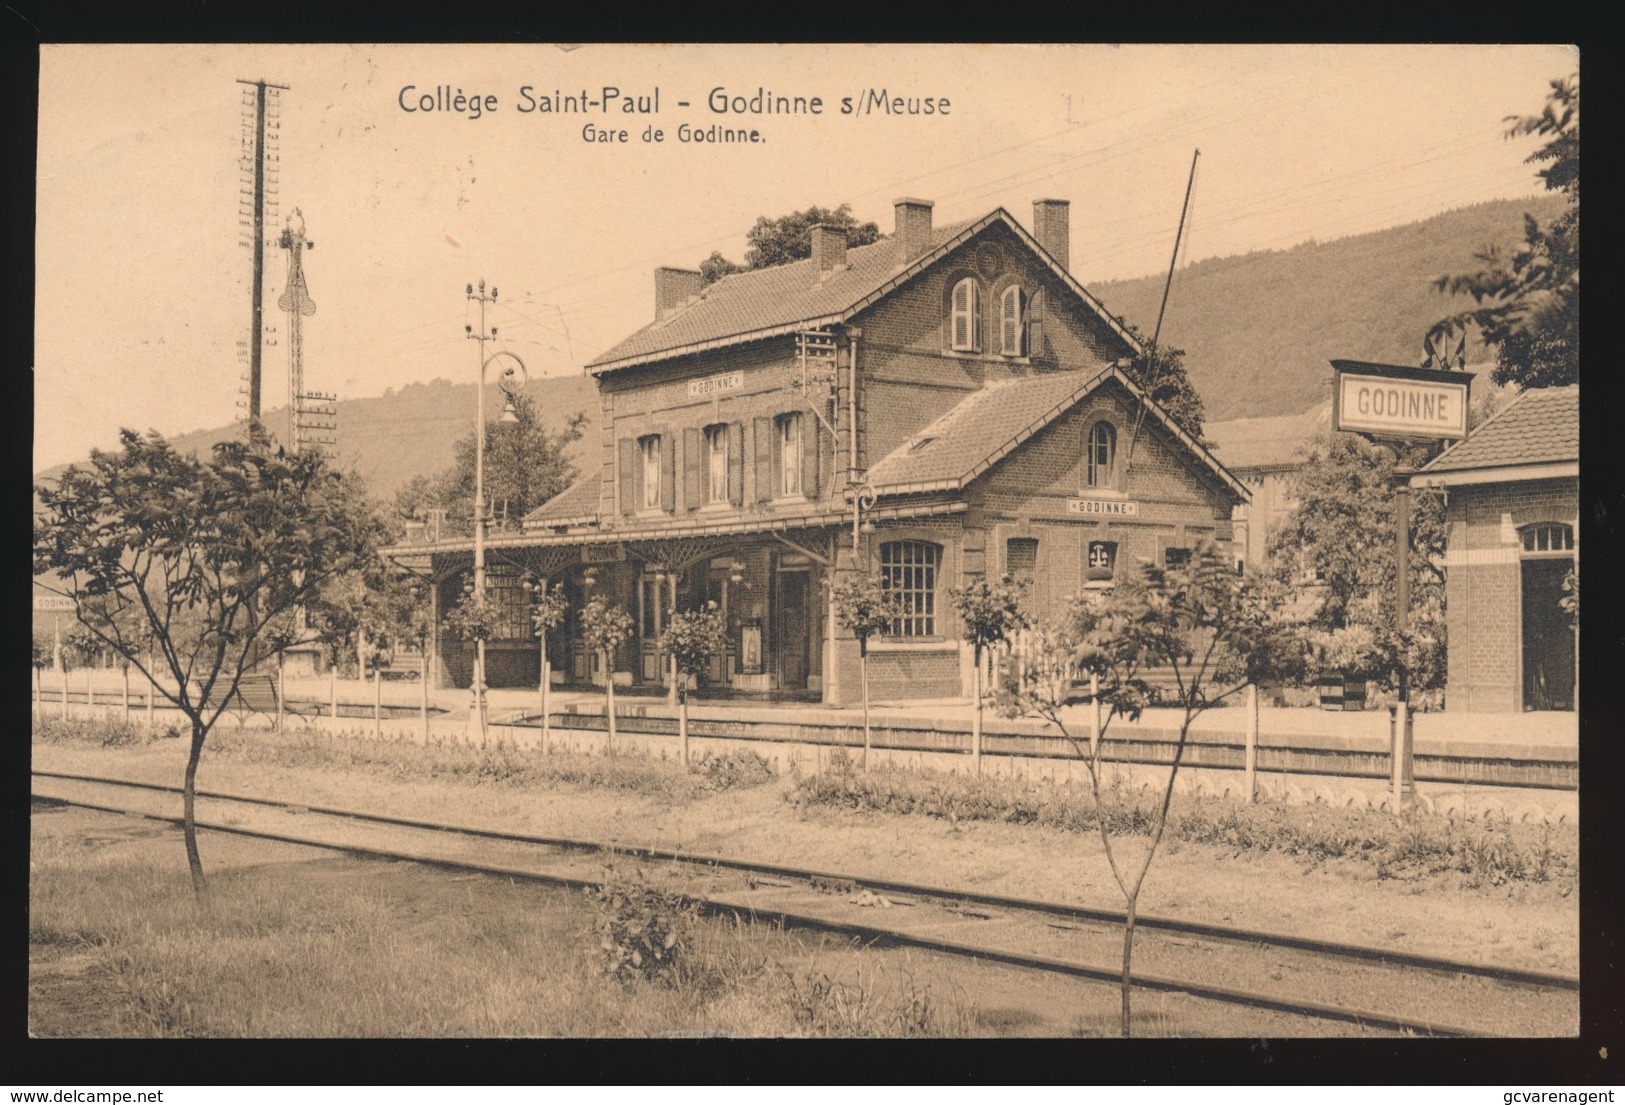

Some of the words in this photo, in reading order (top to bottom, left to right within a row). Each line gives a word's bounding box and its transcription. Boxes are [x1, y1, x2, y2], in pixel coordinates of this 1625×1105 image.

[698, 376, 734, 394] GODINNE
[1358, 387, 1449, 421] GODINNE
[1079, 501, 1127, 514] GODINNE
